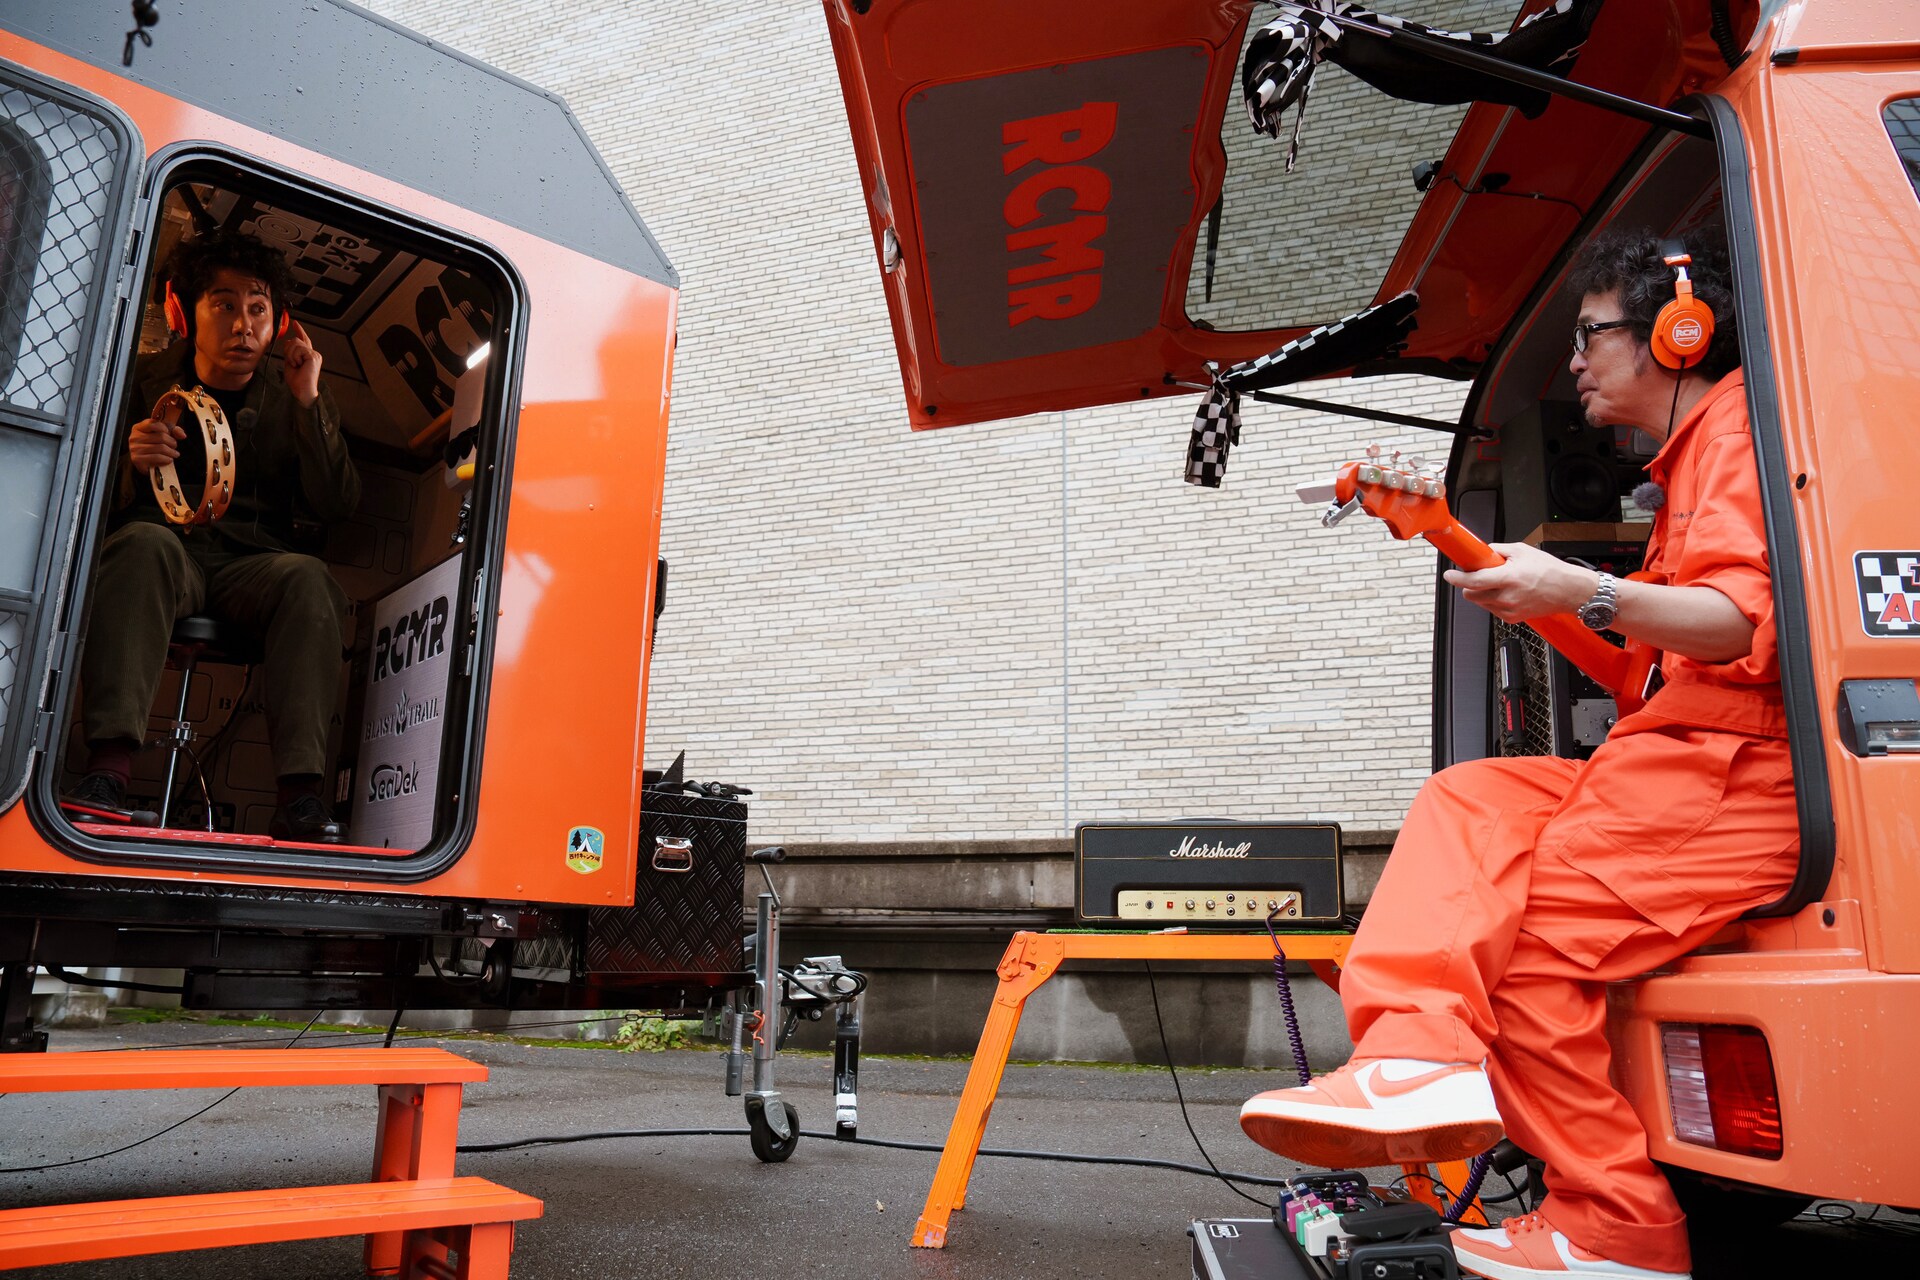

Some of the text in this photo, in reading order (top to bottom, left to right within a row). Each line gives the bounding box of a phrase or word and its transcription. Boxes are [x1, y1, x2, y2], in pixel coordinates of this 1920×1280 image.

[1002, 101, 1119, 328] RCMR
[373, 595, 449, 683] RCMR
[364, 714, 396, 742] BLAST
[407, 697, 439, 728] TRAIL
[367, 761, 419, 803] SeaDek
[1169, 835, 1252, 859] Marshall
